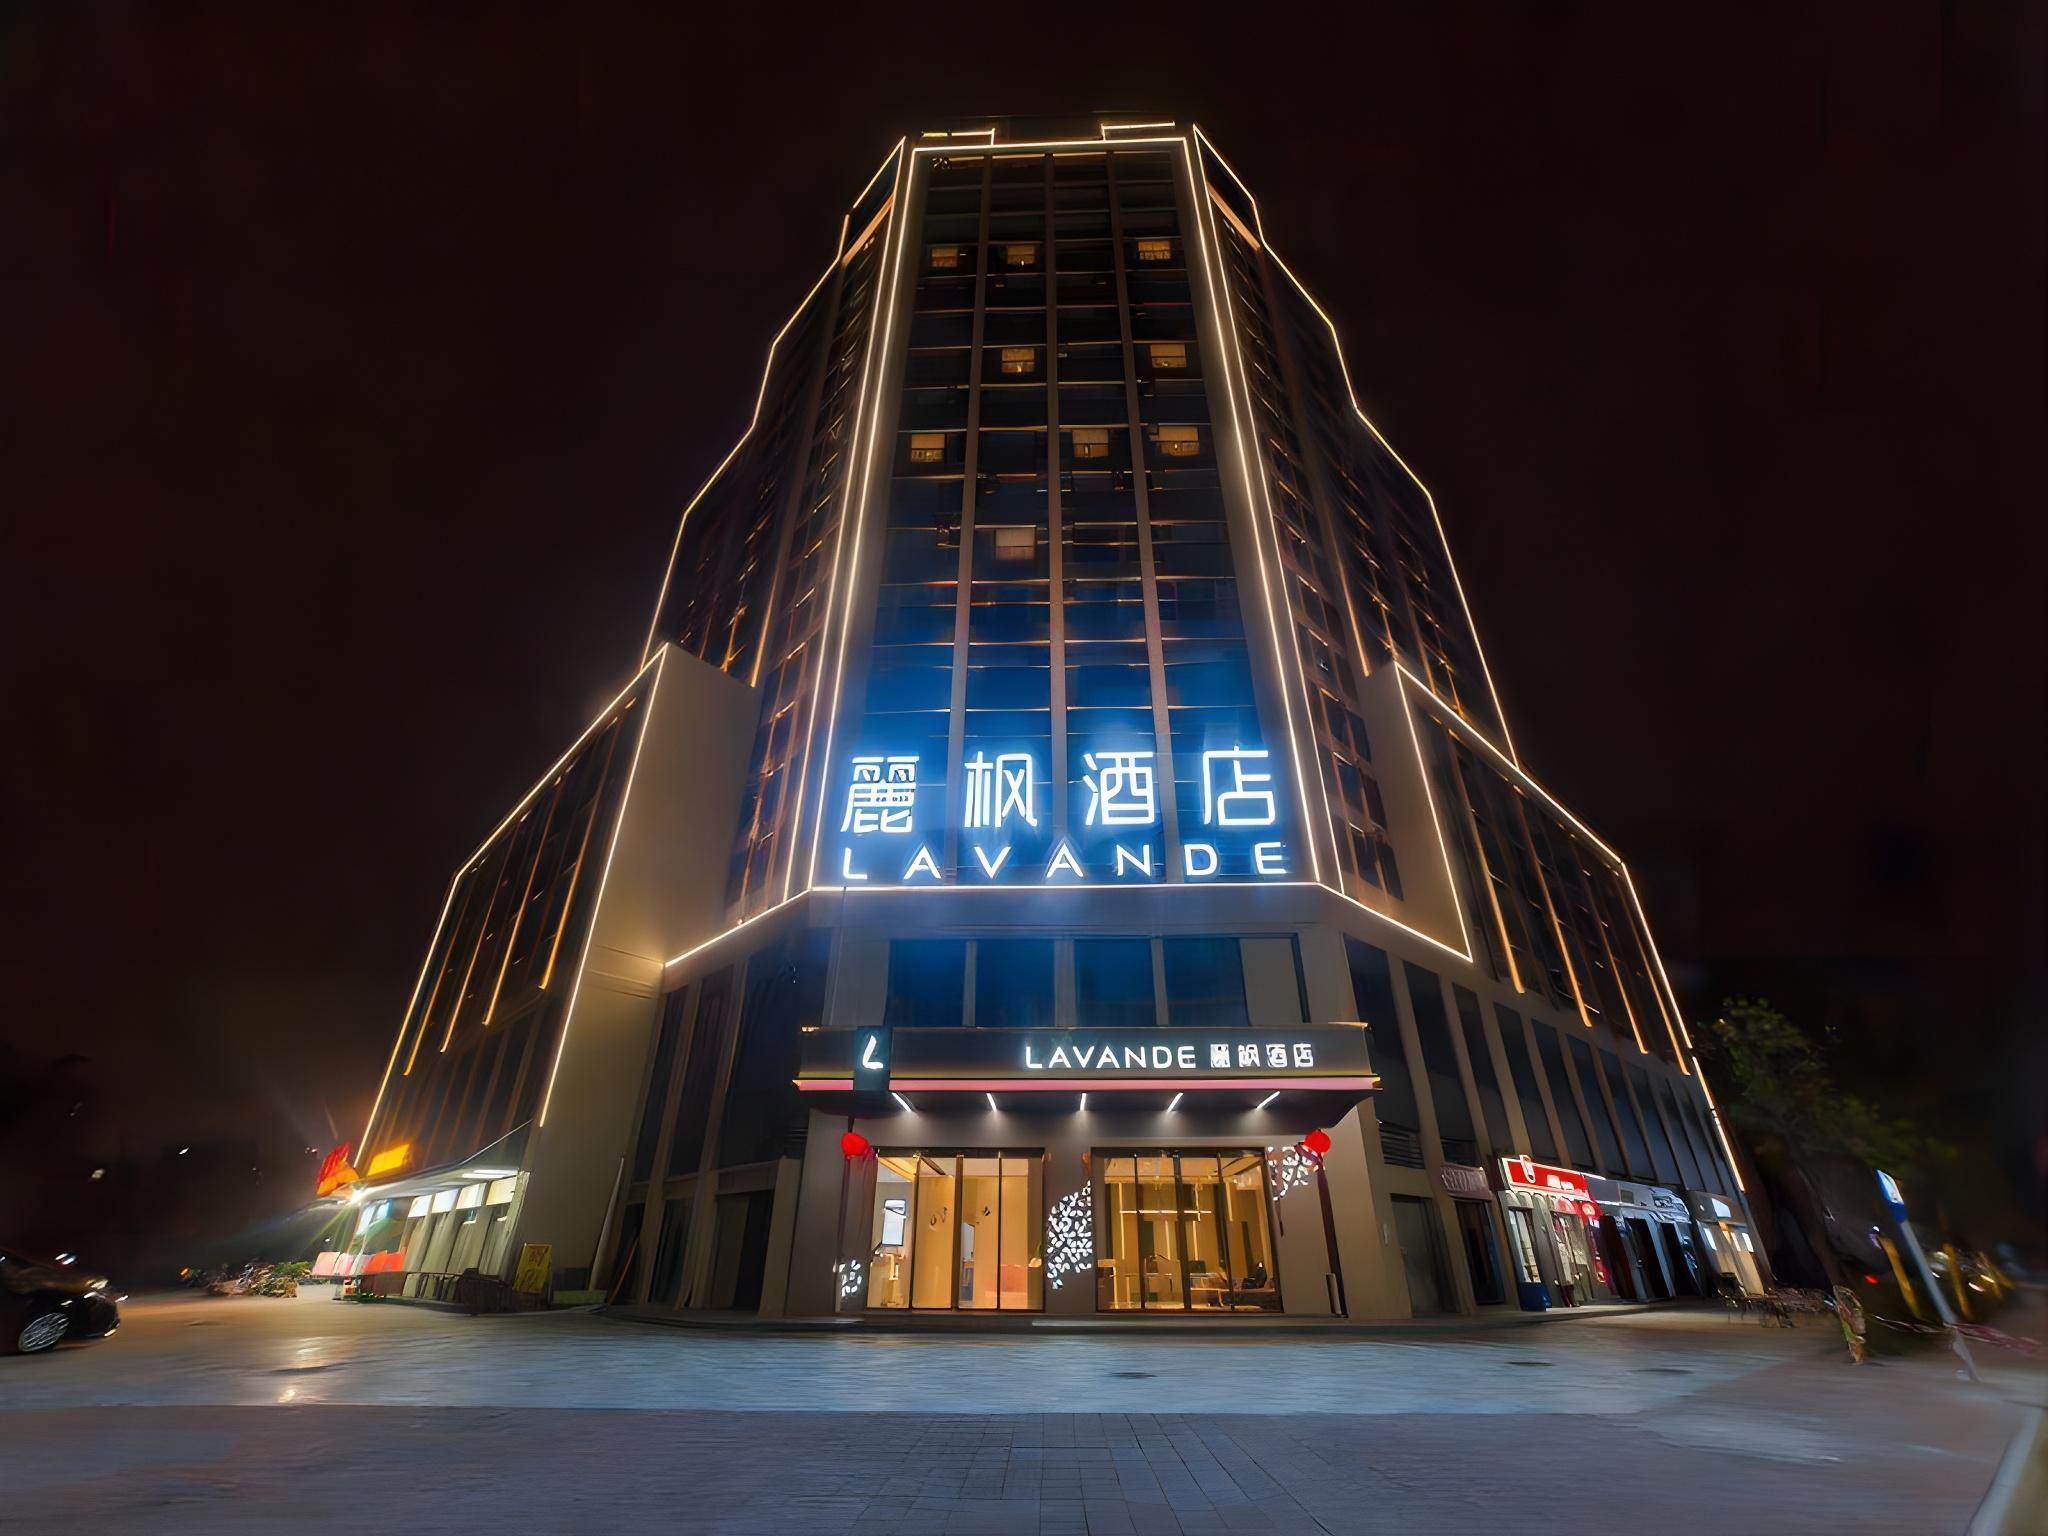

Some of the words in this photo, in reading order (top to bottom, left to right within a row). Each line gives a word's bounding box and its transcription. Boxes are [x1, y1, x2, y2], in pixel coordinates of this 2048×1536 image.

[841, 745, 1276, 834] 麗枫酒店
[842, 841, 1288, 879] LAVANDE
[1024, 1045, 1197, 1069] LAVANDE
